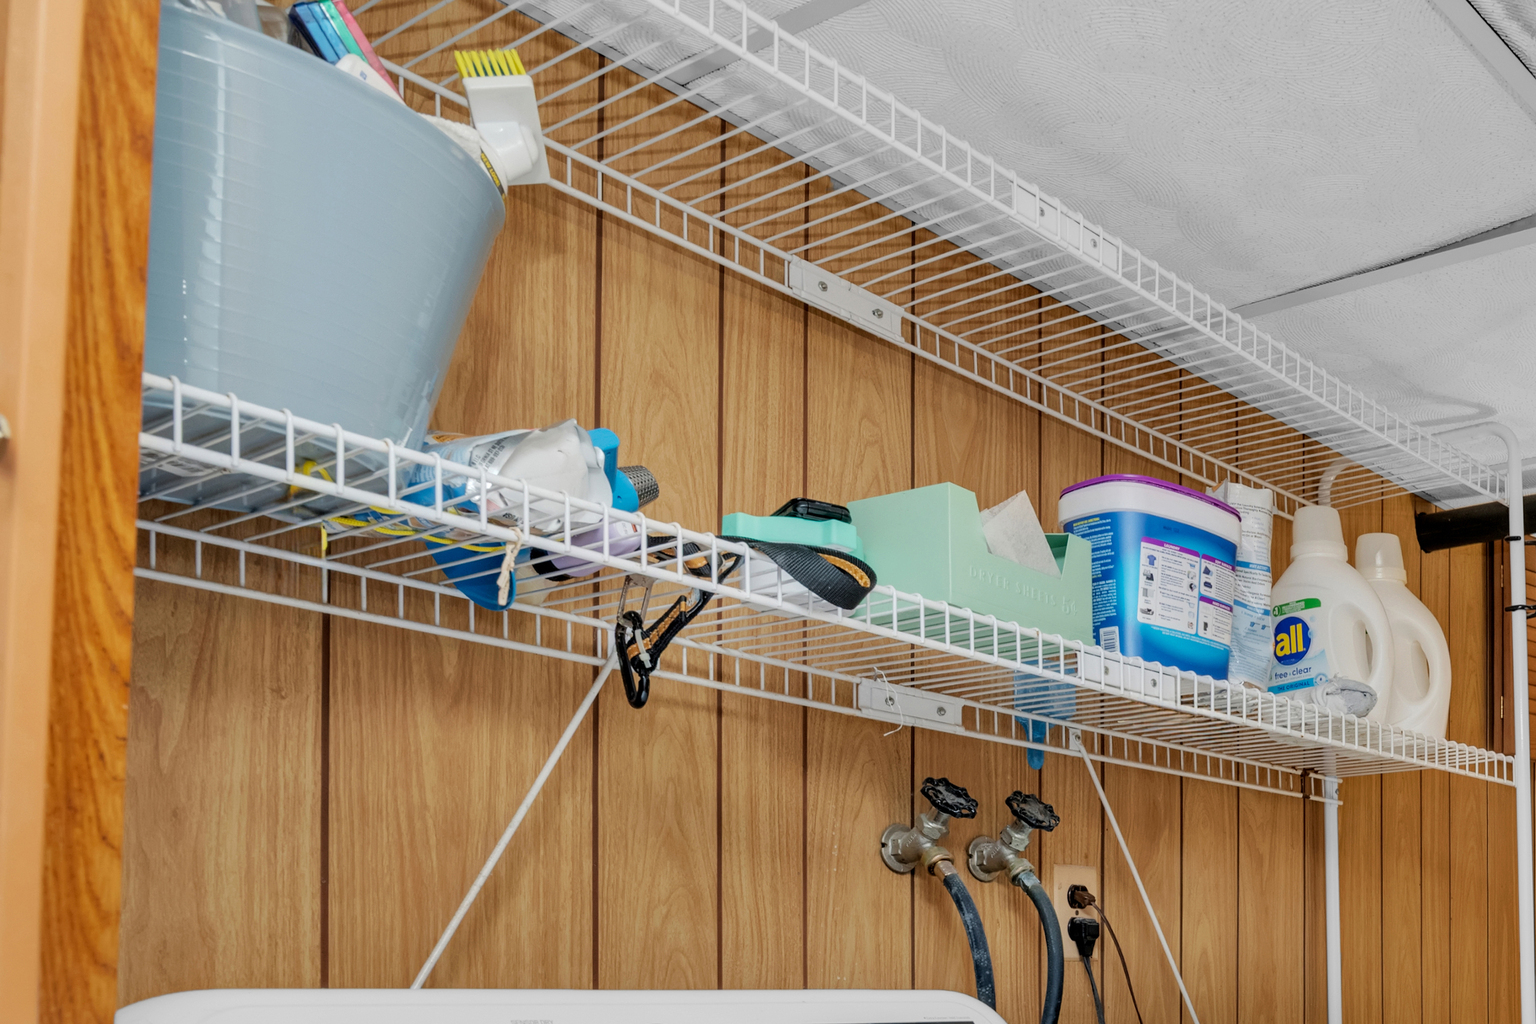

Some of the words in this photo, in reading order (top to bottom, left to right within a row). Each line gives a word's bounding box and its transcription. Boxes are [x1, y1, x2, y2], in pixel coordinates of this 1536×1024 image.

[968, 565, 1010, 590] DRYER
[1015, 581, 1057, 607] SHEETS
[1275, 623, 1304, 657] all
[1274, 671, 1288, 680] free
[1291, 666, 1312, 677] clear
[1286, 681, 1311, 690] ORIGINAL
